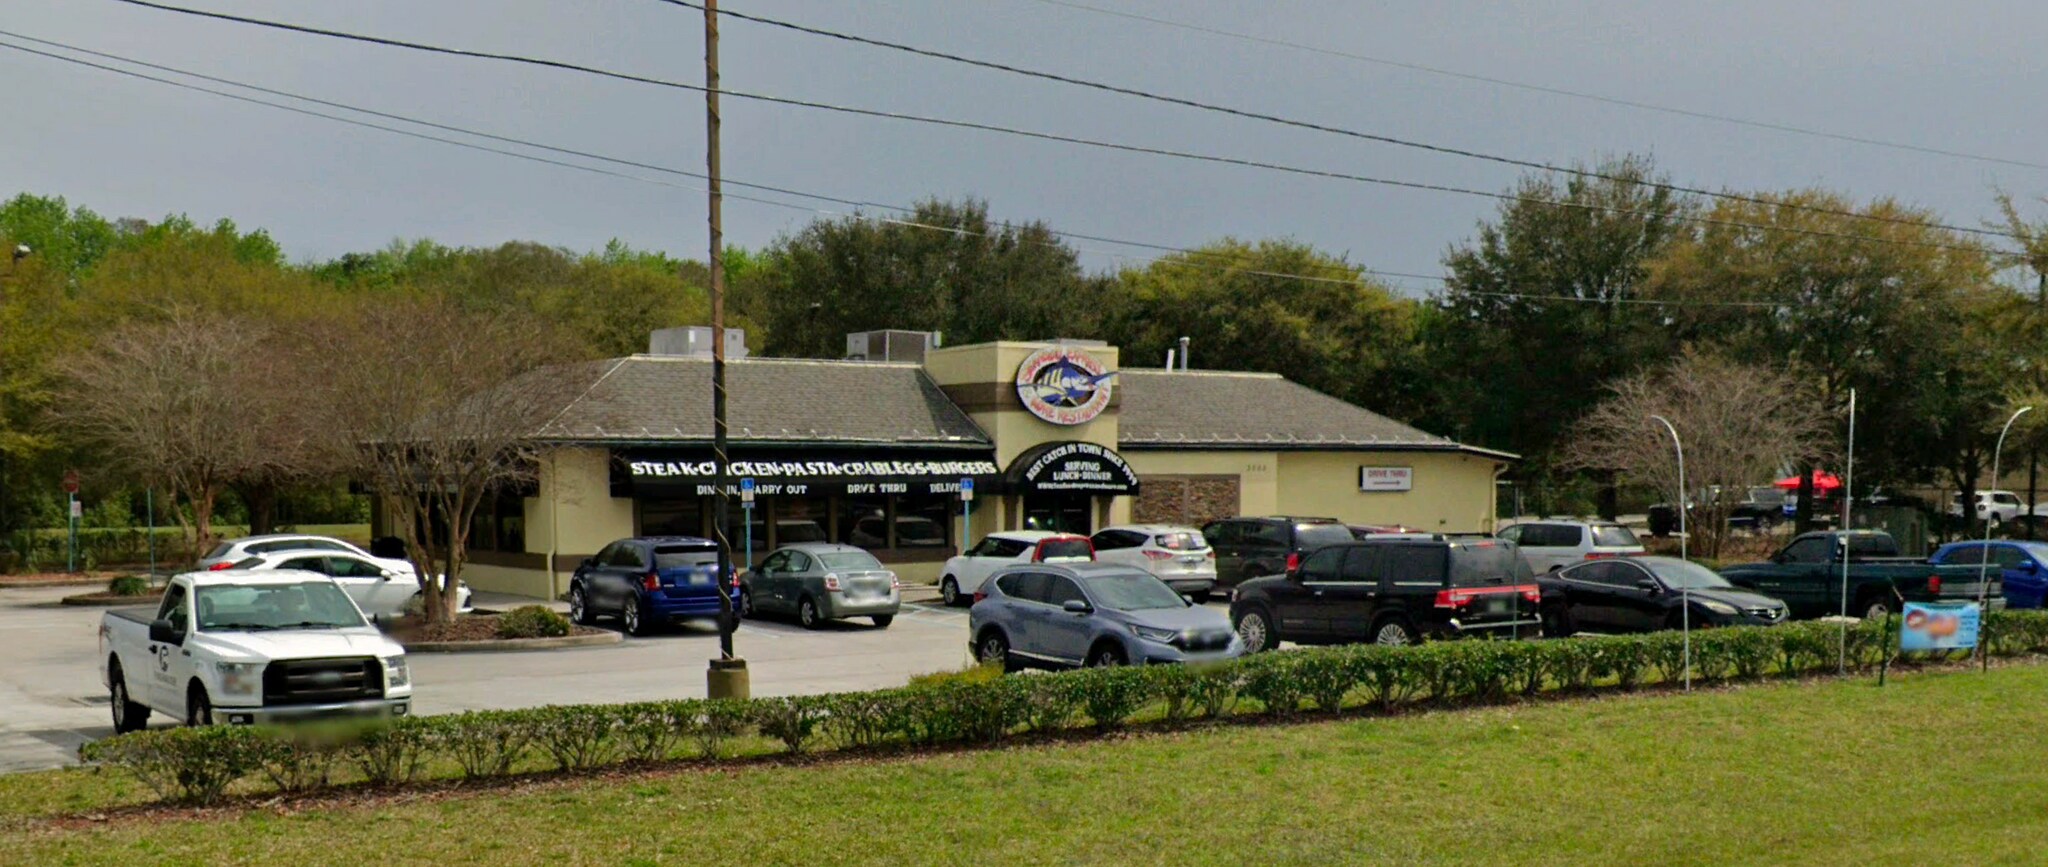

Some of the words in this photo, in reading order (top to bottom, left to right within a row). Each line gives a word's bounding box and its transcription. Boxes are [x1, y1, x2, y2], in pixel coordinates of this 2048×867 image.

[1026, 460, 1044, 481] BEST
[1042, 446, 1067, 464] CATCH
[1067, 443, 1077, 454] IN
[1078, 443, 1102, 456] TOWN
[1103, 449, 1124, 468] SINCE
[1064, 461, 1100, 471] SERVING
[1368, 470, 1387, 478] DRIVE
[1389, 470, 1407, 478] THRU
[697, 484, 716, 495] DIN
[754, 485, 782, 495] ARRY
[786, 485, 807, 494] OUT
[847, 484, 875, 494] DRIVE
[879, 484, 907, 493] THRU
